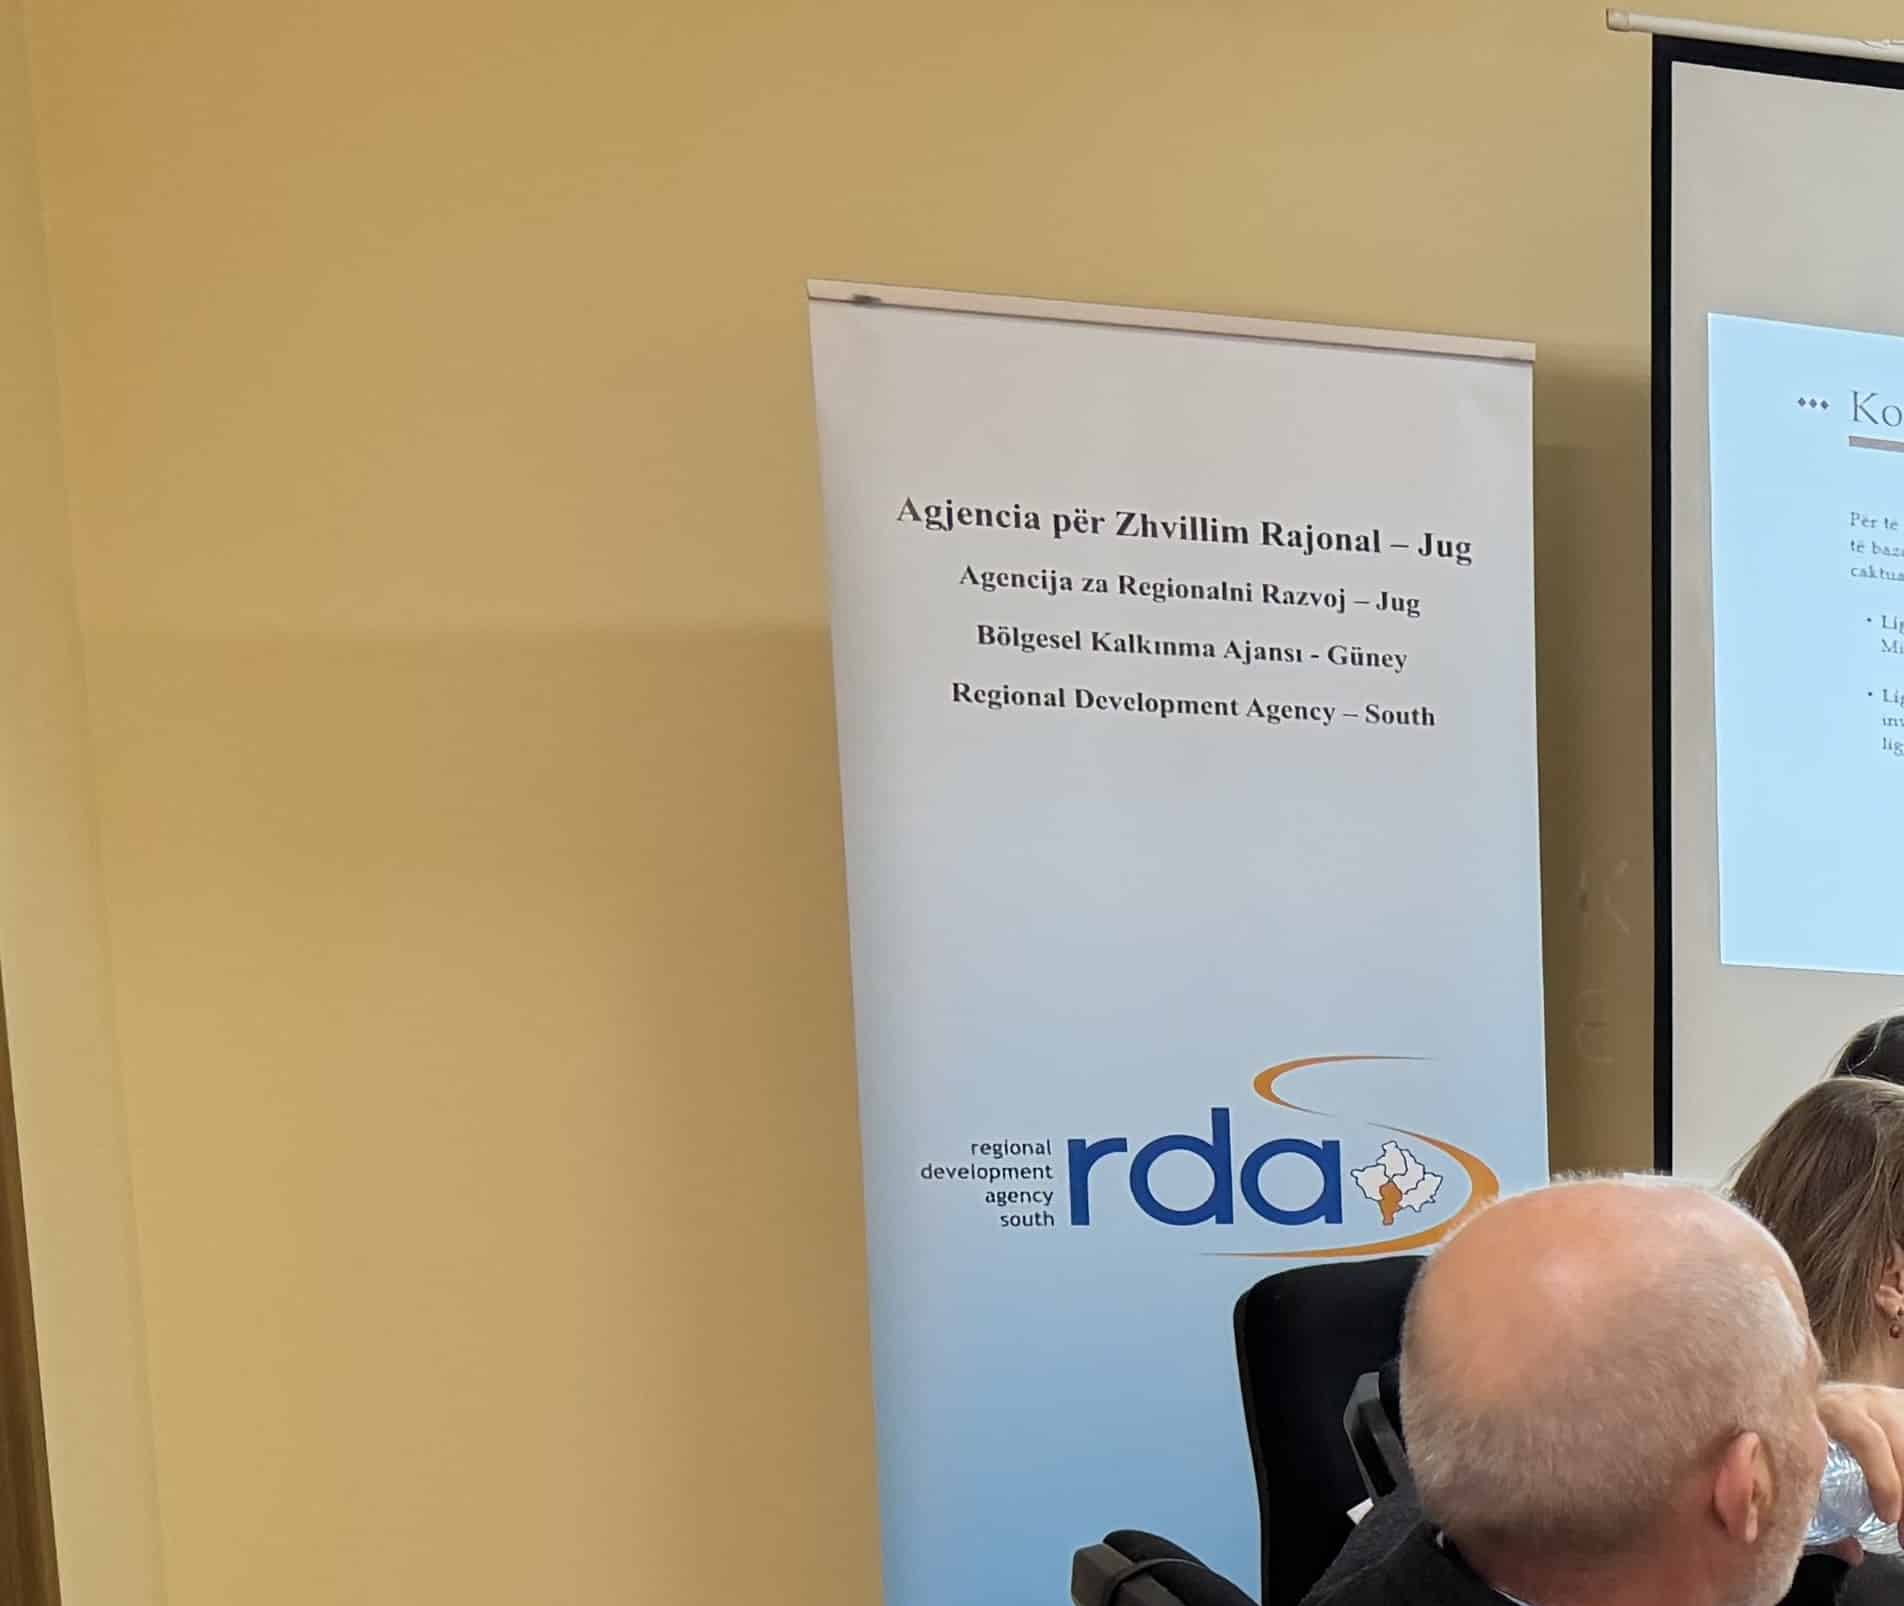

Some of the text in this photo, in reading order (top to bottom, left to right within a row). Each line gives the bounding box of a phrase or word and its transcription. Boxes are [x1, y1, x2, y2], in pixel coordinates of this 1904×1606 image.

[895, 495, 1041, 532] Agjencia
[1052, 507, 1106, 540] për
[1115, 510, 1249, 545] Zhvillim
[1261, 520, 1381, 556] Rajonal
[1417, 531, 1473, 566] Jug
[959, 564, 1073, 597] Agencija
[1081, 576, 1109, 593] za
[1118, 573, 1253, 603] Regionalni
[1262, 582, 1346, 614] Razvoj
[1375, 590, 1421, 618] Jug
[976, 623, 1082, 654] Bölgesel
[1091, 630, 1216, 658] Kalkınma
[1223, 639, 1303, 666] Ajansı
[1327, 643, 1408, 674] Güney
[952, 681, 1066, 710] Regional
[1075, 687, 1239, 719] Development
[1245, 696, 1336, 727] Agency
[1365, 702, 1436, 726] South
[972, 1138, 1052, 1160] regional
[1067, 1107, 1343, 1226] rda
[920, 1161, 1054, 1184] development
[985, 1188, 1054, 1208] agency
[1000, 1209, 1055, 1228] south
